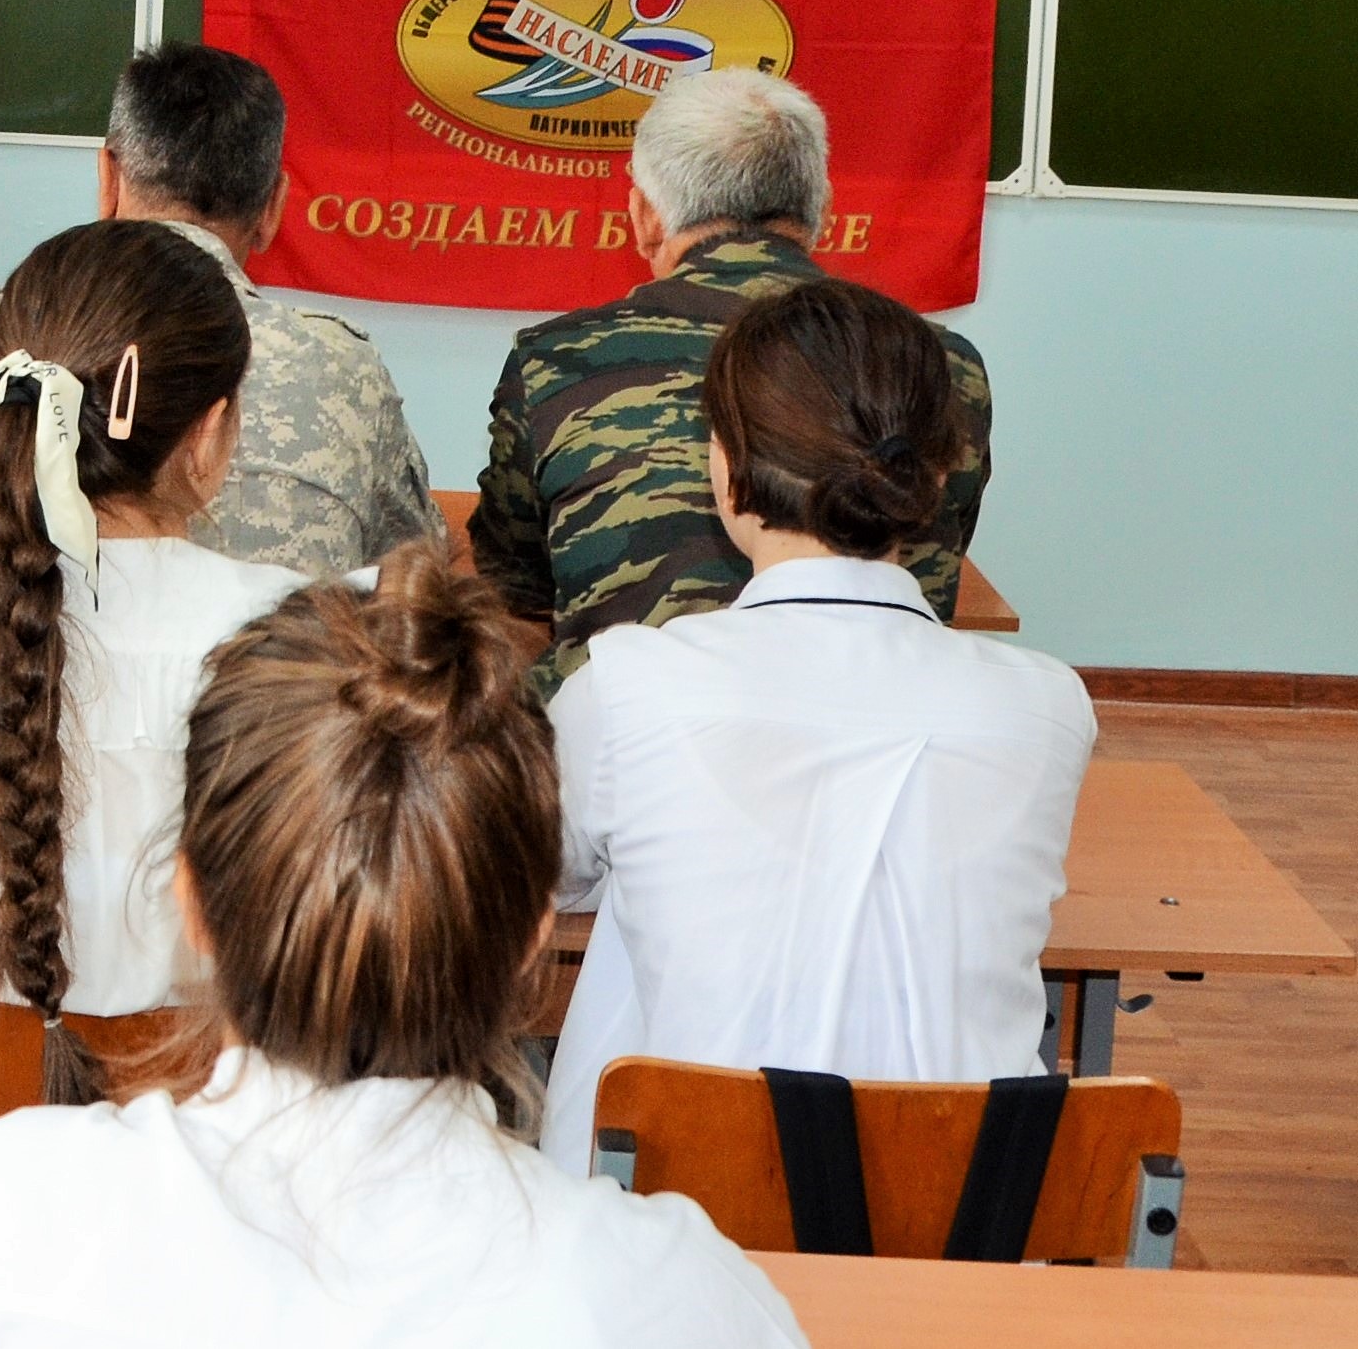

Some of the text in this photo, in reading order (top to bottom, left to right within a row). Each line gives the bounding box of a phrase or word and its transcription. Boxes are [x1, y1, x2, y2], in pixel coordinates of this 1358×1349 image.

[516, 8, 674, 91] НАСЛЕДИЕ
[406, 101, 612, 178] РЕГИОНАЛЬНОЕ
[529, 113, 638, 138] ПАТРИОТИЧЕС
[307, 193, 582, 252] СОЗДАЕМ
[49, 392, 69, 443] LOVE
